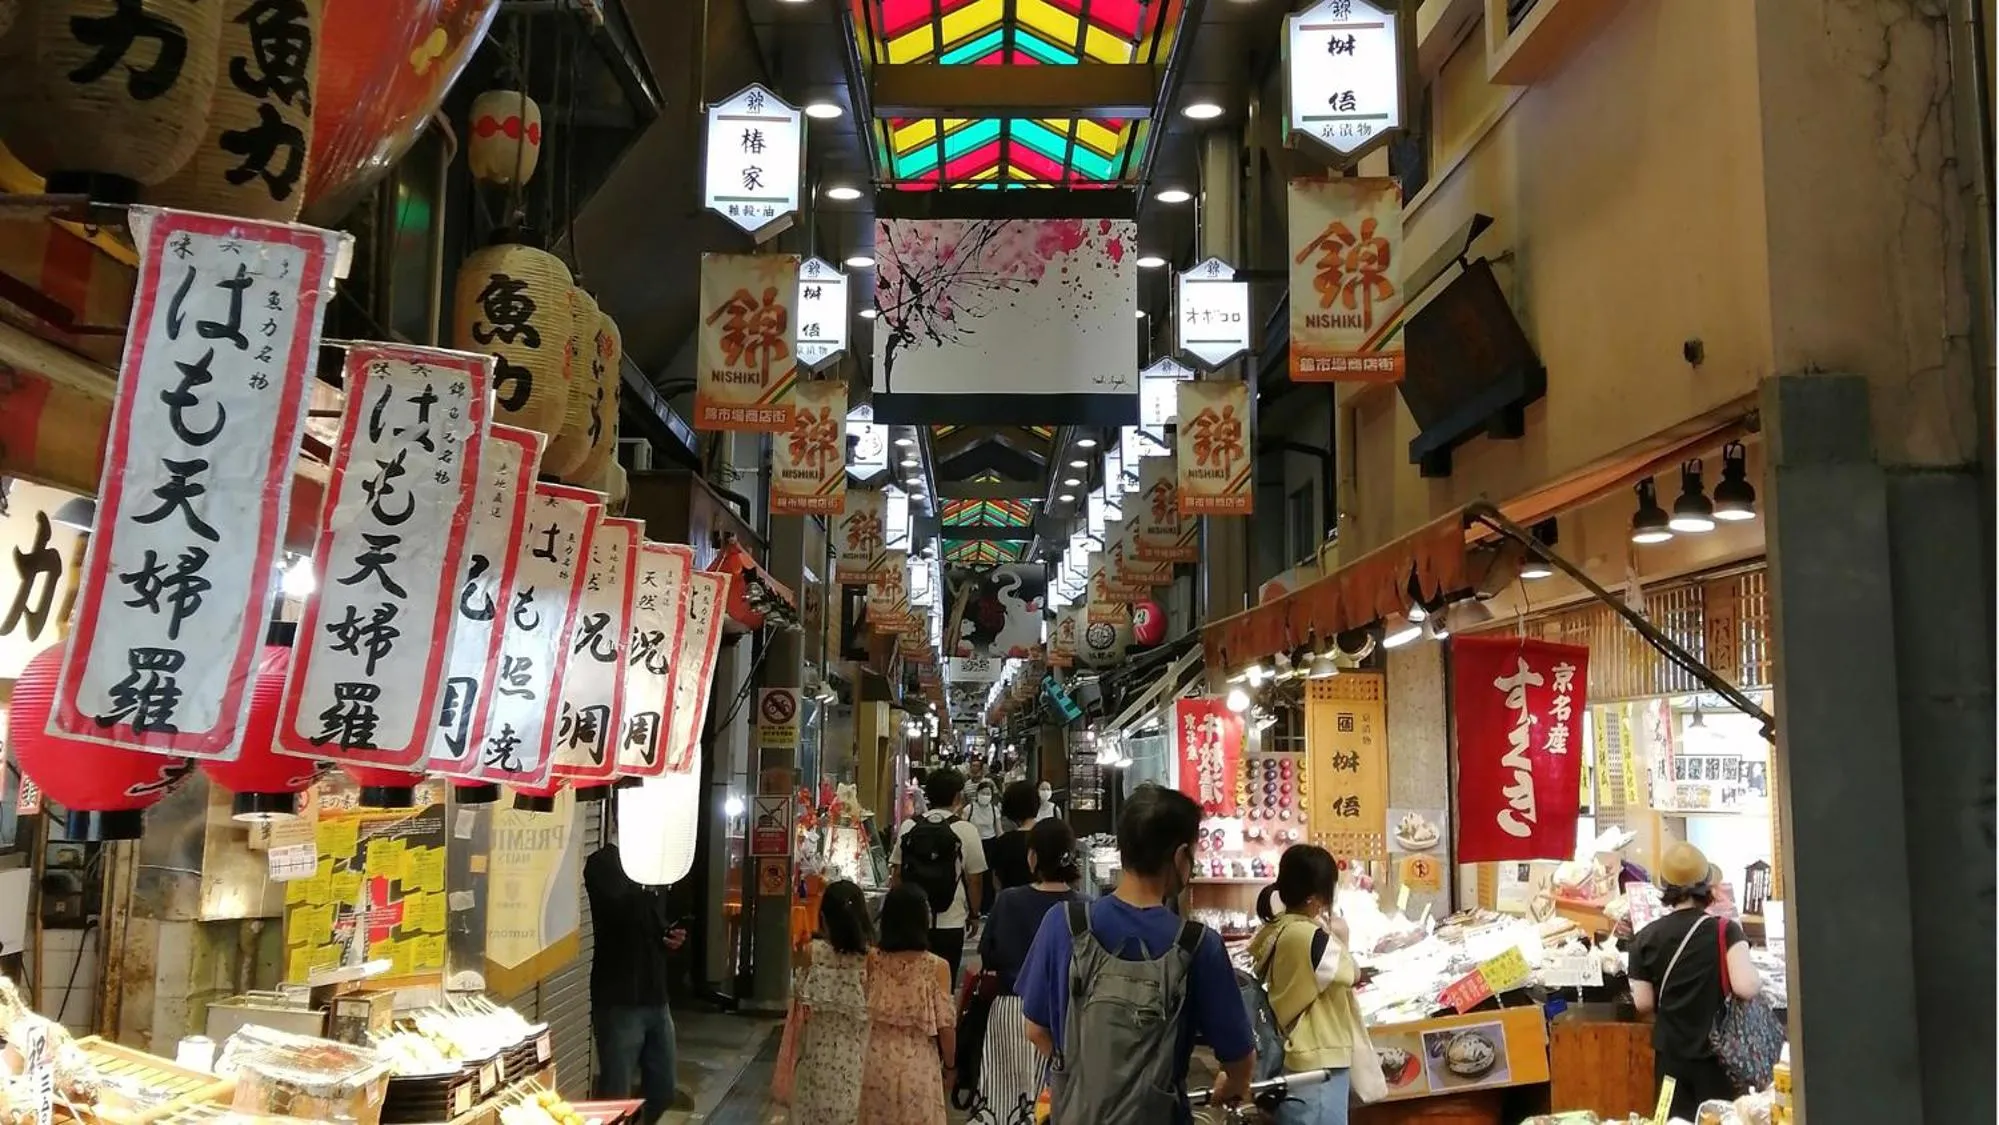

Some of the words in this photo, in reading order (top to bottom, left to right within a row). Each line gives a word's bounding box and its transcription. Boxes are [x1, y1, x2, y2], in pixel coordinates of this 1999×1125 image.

[741, 128, 767, 191] 椿家
[1322, 123, 1372, 137] 京漬物
[1295, 217, 1395, 332] 錦
[706, 286, 789, 388] 錦
[1305, 314, 1363, 329] NISHIKI
[711, 370, 760, 385] NISHIKI
[1299, 357, 1394, 372] 錦市場商店街
[704, 407, 787, 424] 錦市場商店街
[779, 405, 839, 483] 錦
[1181, 405, 1244, 482] 錦
[95, 263, 253, 735] はも天婦羅
[782, 468, 819, 480] NISHIKI
[1187, 468, 1225, 479] NISHIKI
[1542, 661, 1576, 755] 京名産
[1494, 656, 1544, 838] すぐき
